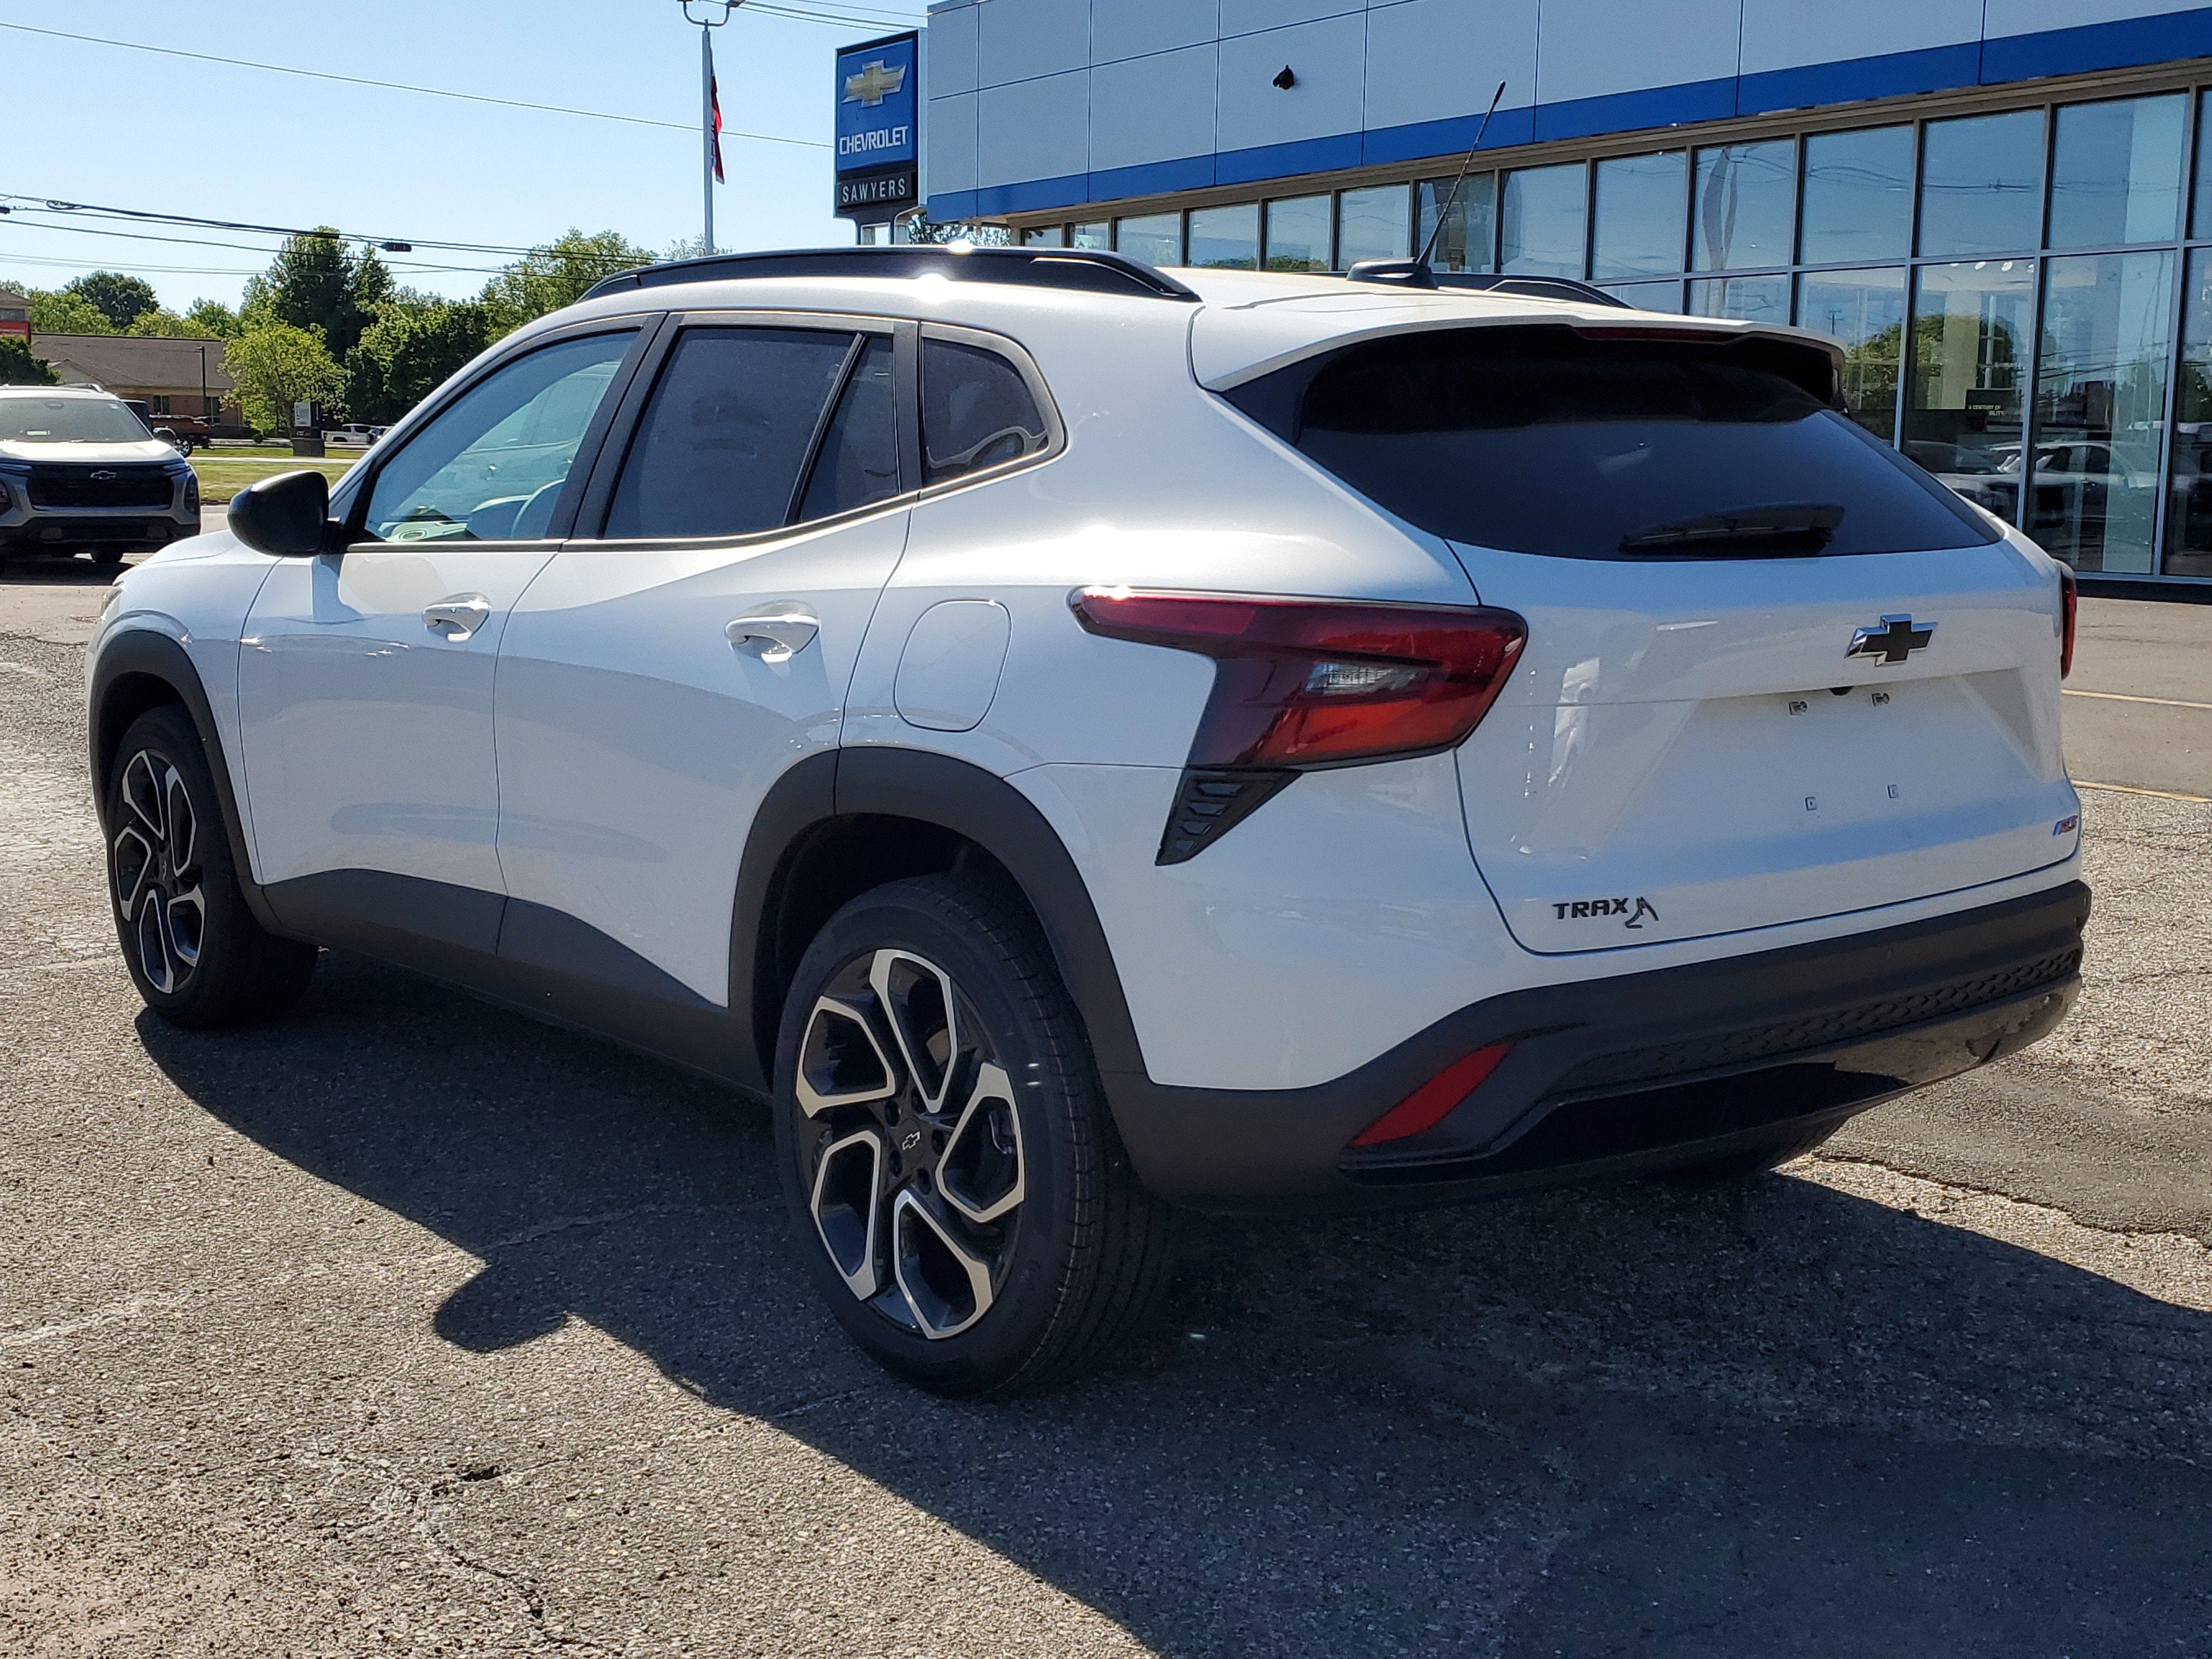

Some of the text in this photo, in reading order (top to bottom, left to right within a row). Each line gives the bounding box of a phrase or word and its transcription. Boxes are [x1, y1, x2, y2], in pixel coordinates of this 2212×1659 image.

[839, 126, 909, 155] CHEVROLET
[842, 177, 906, 203] SAWYERS
[1553, 898, 1629, 919] TRAX
